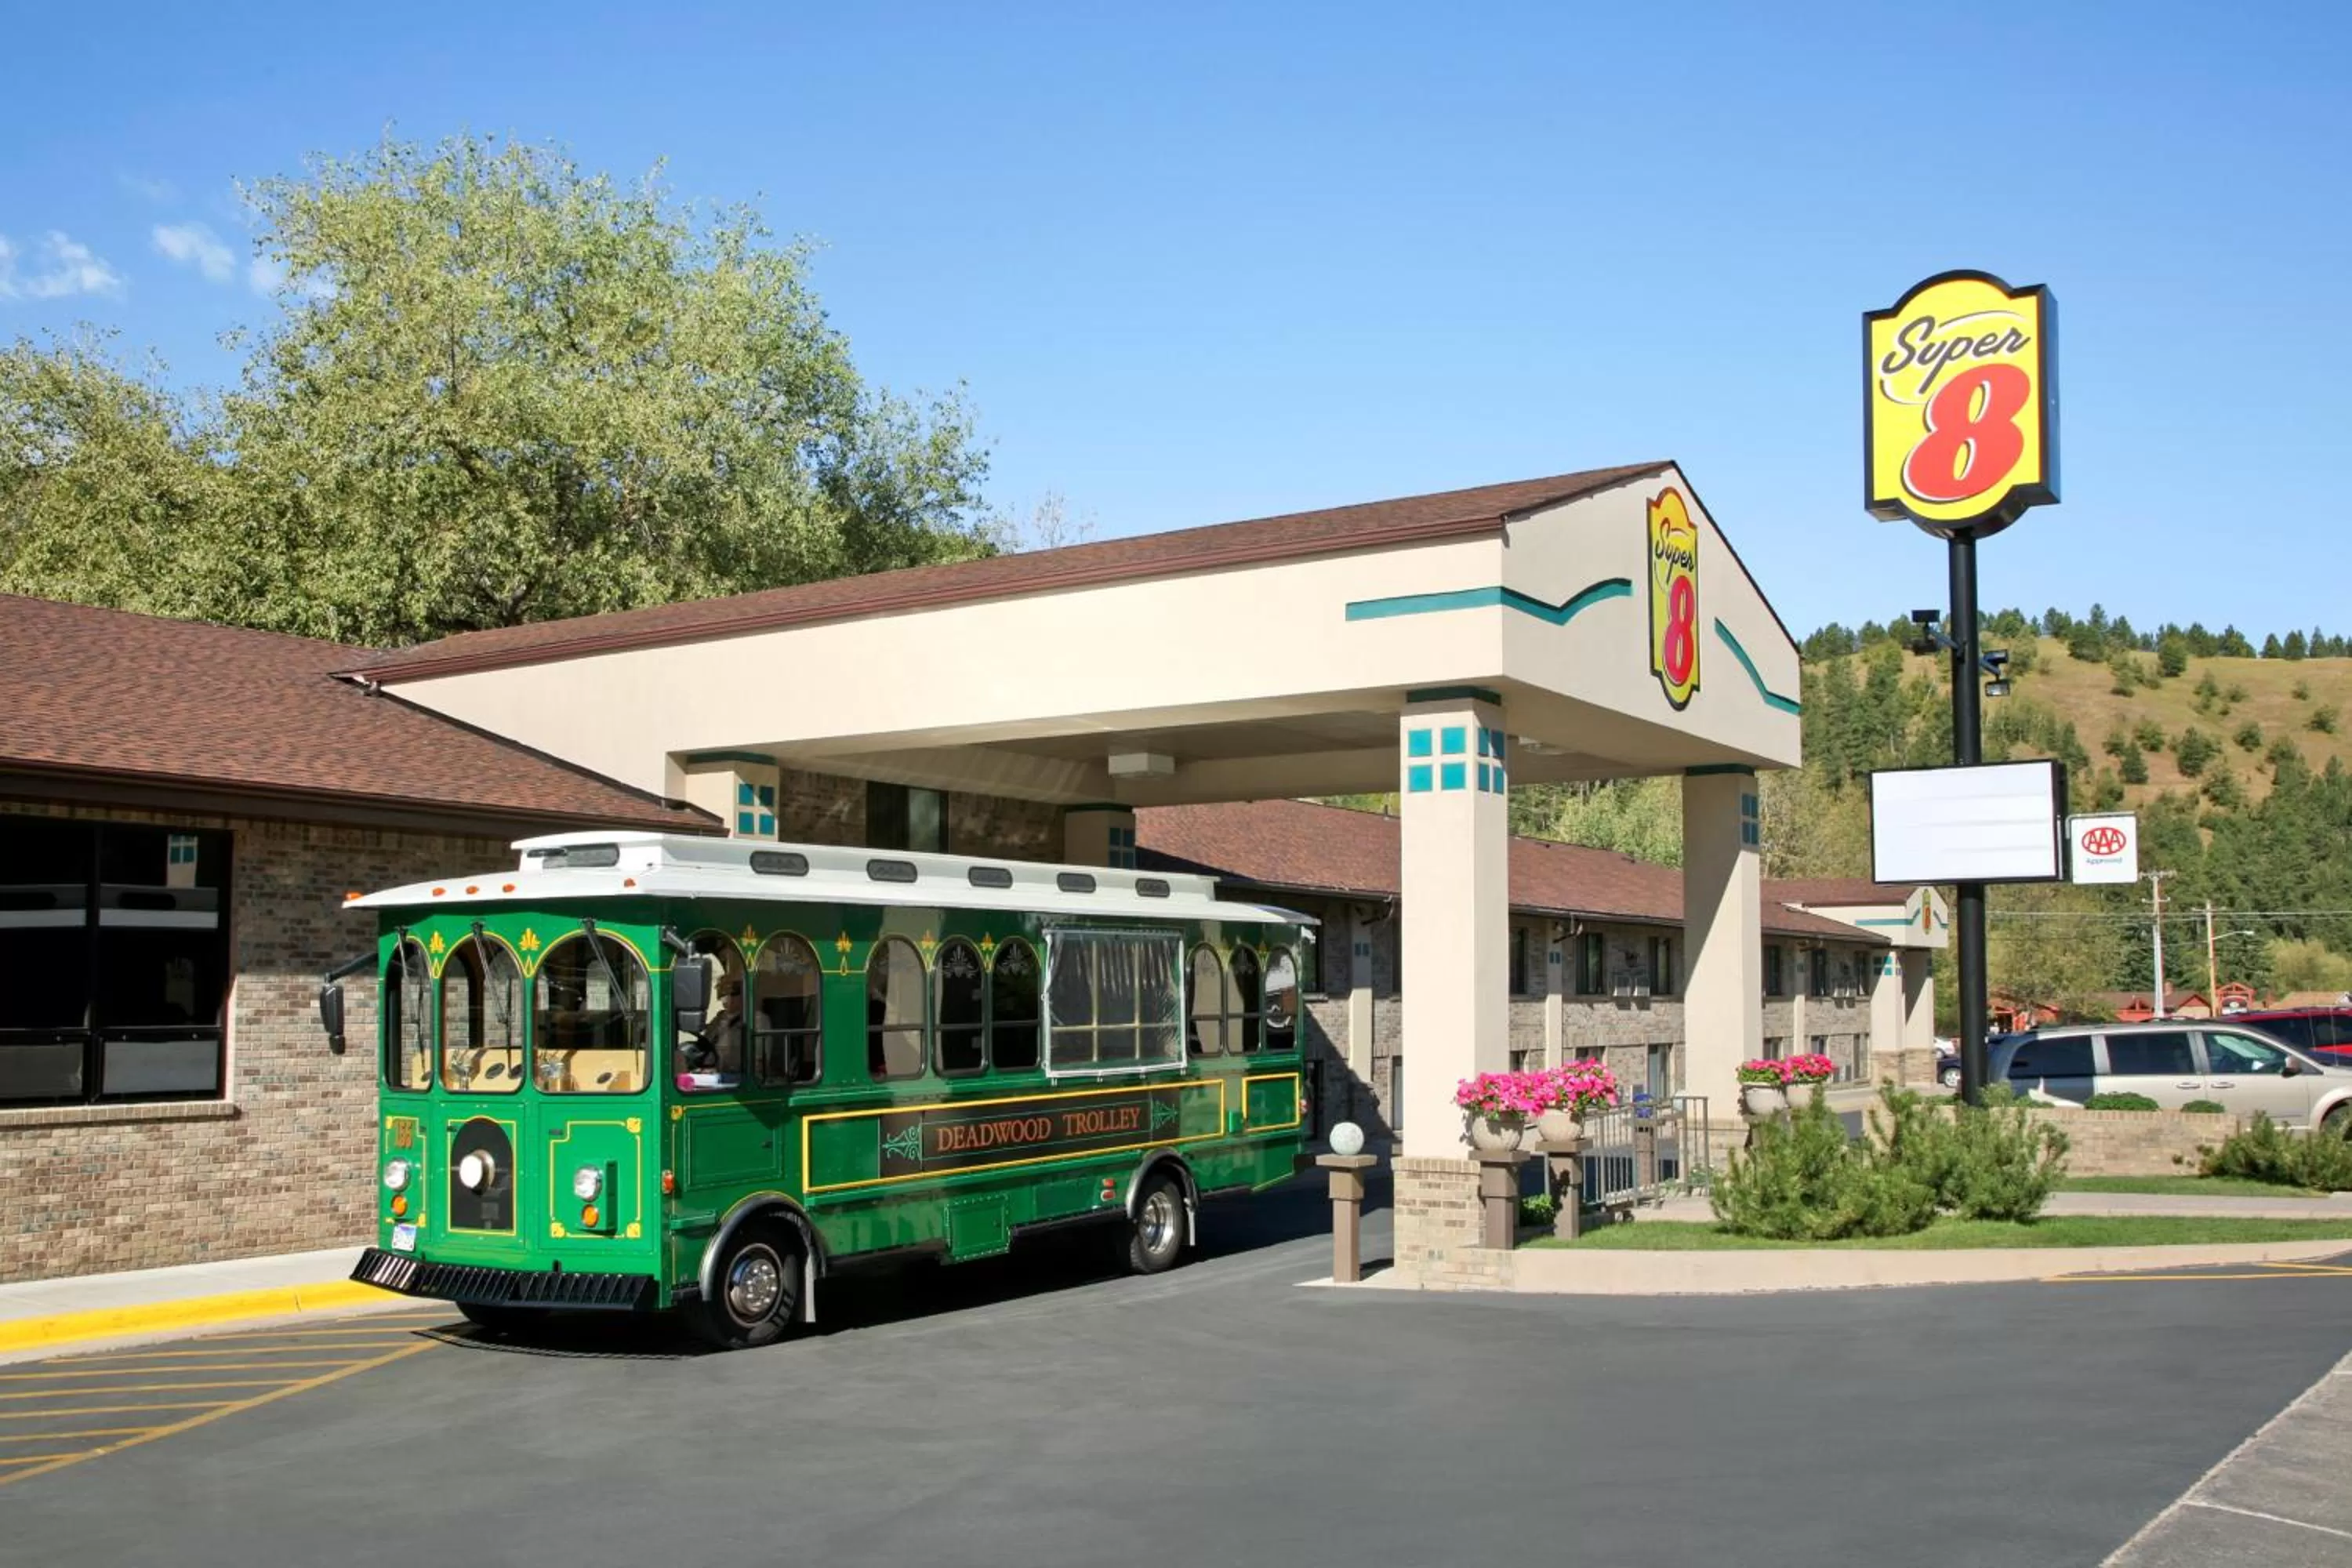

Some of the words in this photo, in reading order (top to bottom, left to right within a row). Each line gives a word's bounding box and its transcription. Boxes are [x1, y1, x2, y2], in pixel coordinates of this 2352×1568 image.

[1882, 315, 2031, 394] Super
[1900, 363, 2031, 504] 8
[1655, 517, 1694, 585] Super
[1663, 575, 1694, 687] 8
[2085, 829, 2122, 854] AAA
[937, 1118, 1051, 1152] DEADWOOD
[1062, 1107, 1141, 1136] TROLLEY
